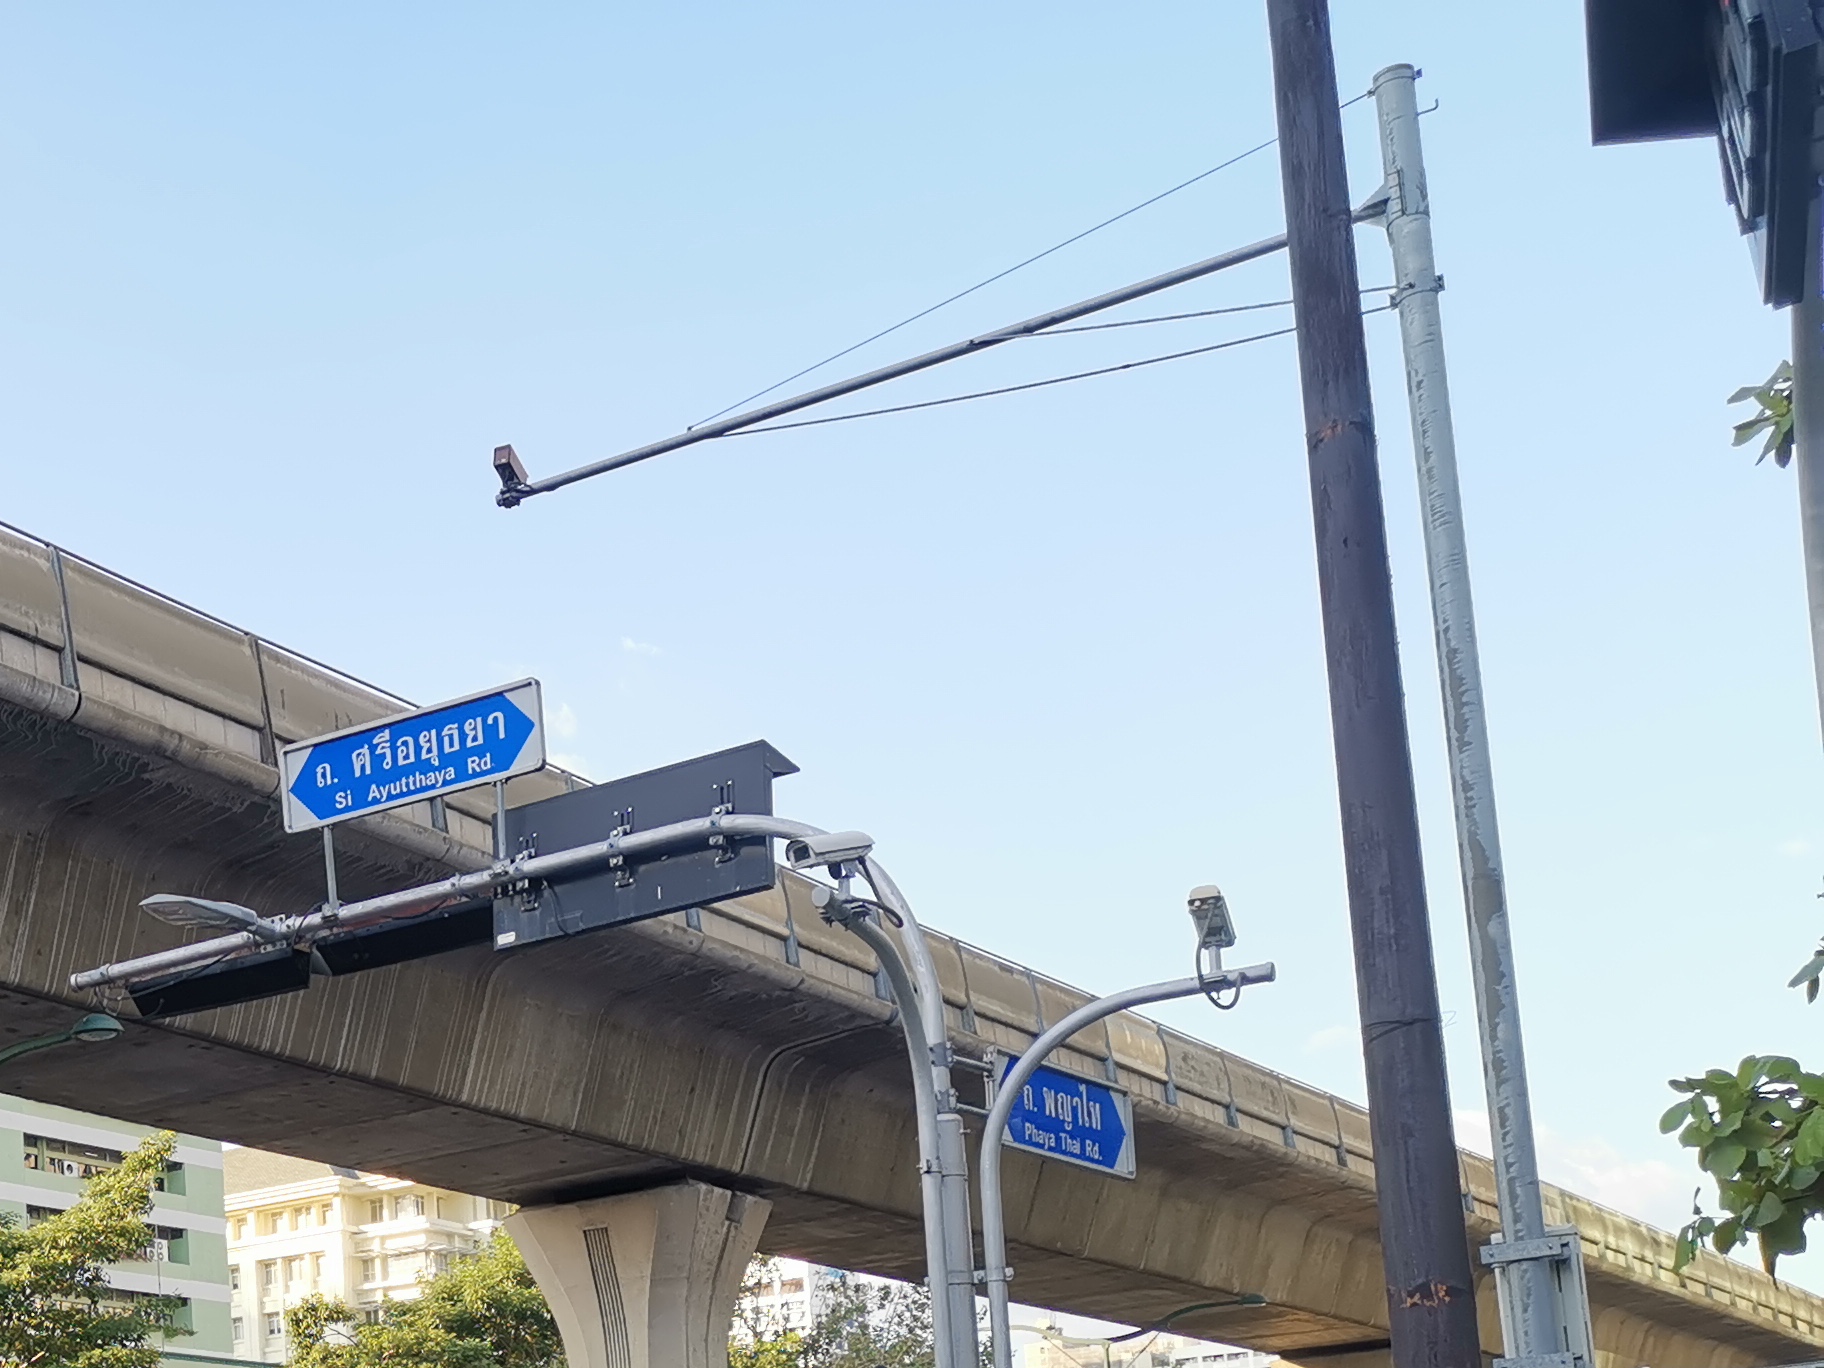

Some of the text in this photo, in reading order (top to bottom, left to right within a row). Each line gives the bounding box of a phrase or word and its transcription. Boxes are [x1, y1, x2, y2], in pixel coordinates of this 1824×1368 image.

[316, 711, 507, 788] ถ. ศรีอยุธยา
[335, 789, 352, 809] Si
[367, 764, 455, 803] Ayutthaya
[1023, 1083, 1102, 1130] ถ. พญาไท
[1025, 1122, 1103, 1160] Phaya Thai Rd.
